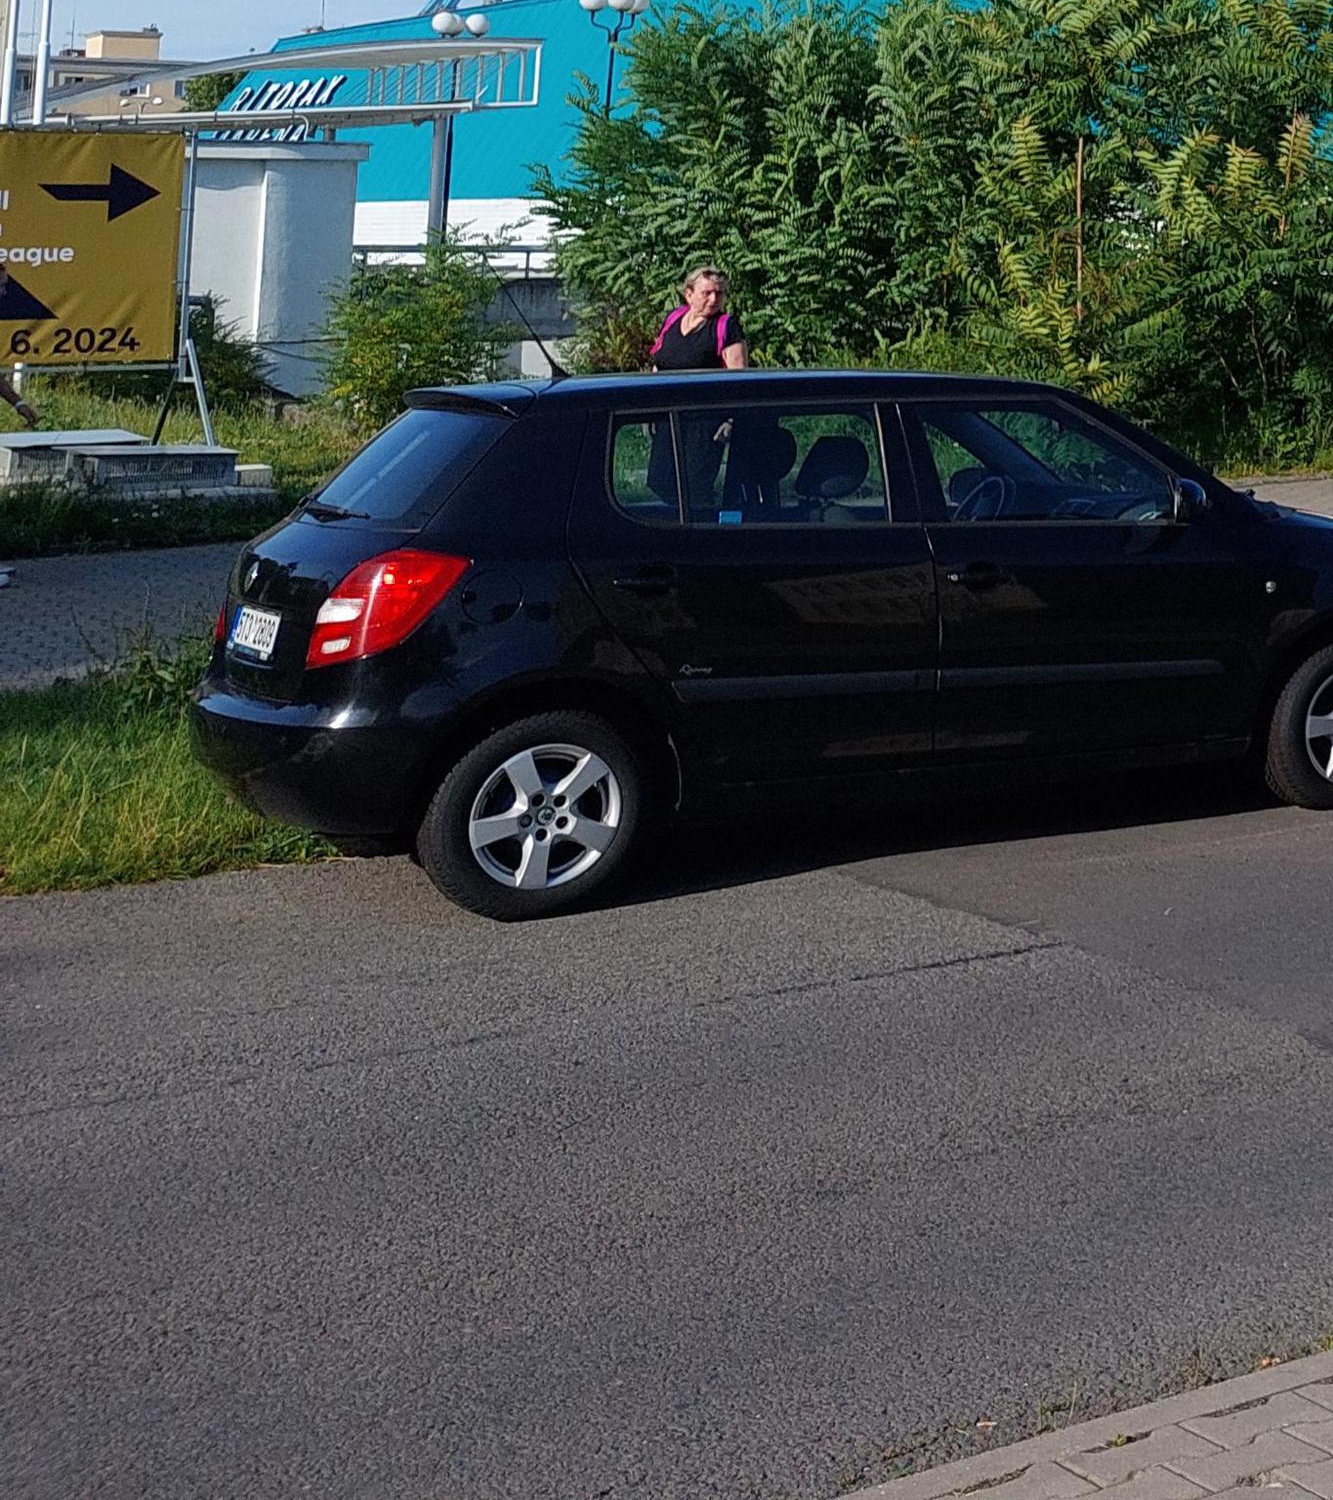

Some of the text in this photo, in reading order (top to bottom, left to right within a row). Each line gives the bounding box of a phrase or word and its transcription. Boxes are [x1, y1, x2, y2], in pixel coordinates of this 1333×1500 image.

[257, 75, 344, 110] TORAX
[10, 327, 140, 355] 6. 2024
